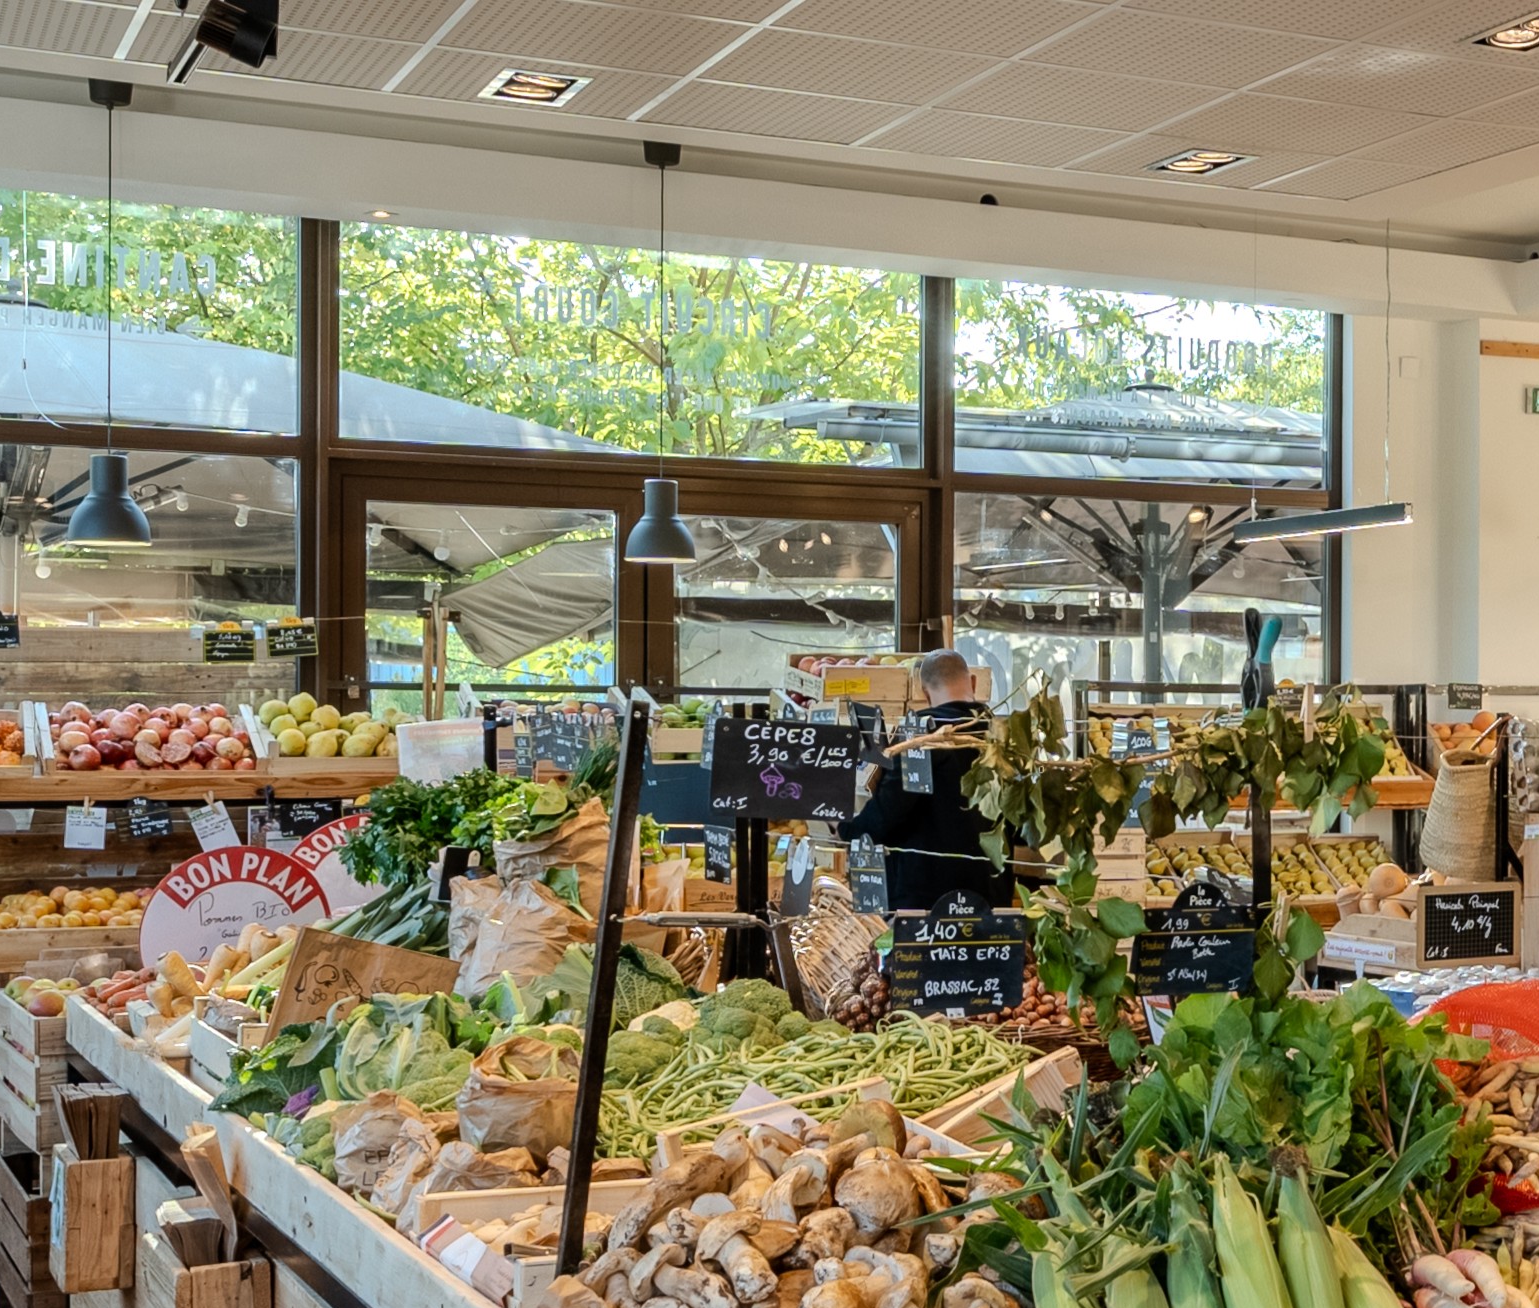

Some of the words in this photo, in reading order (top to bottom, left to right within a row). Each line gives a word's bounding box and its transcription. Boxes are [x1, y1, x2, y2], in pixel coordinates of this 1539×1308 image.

[744, 721, 817, 746] CÈPES
[747, 744, 789, 764] 3,90
[827, 747, 848, 757] LES
[821, 758, 853, 769] 100G
[166, 852, 233, 905] BON
[241, 851, 314, 908] PLAN
[957, 891, 966, 904] la
[1197, 885, 1206, 896] la
[948, 903, 975, 915] Pièce
[1188, 895, 1213, 907] Pièce
[252, 900, 291, 920] BIO
[1161, 918, 1190, 934] 1,99
[1450, 916, 1475, 933] 4,10
[914, 920, 957, 946] 1,40
[930, 945, 969, 961] MAÏS
